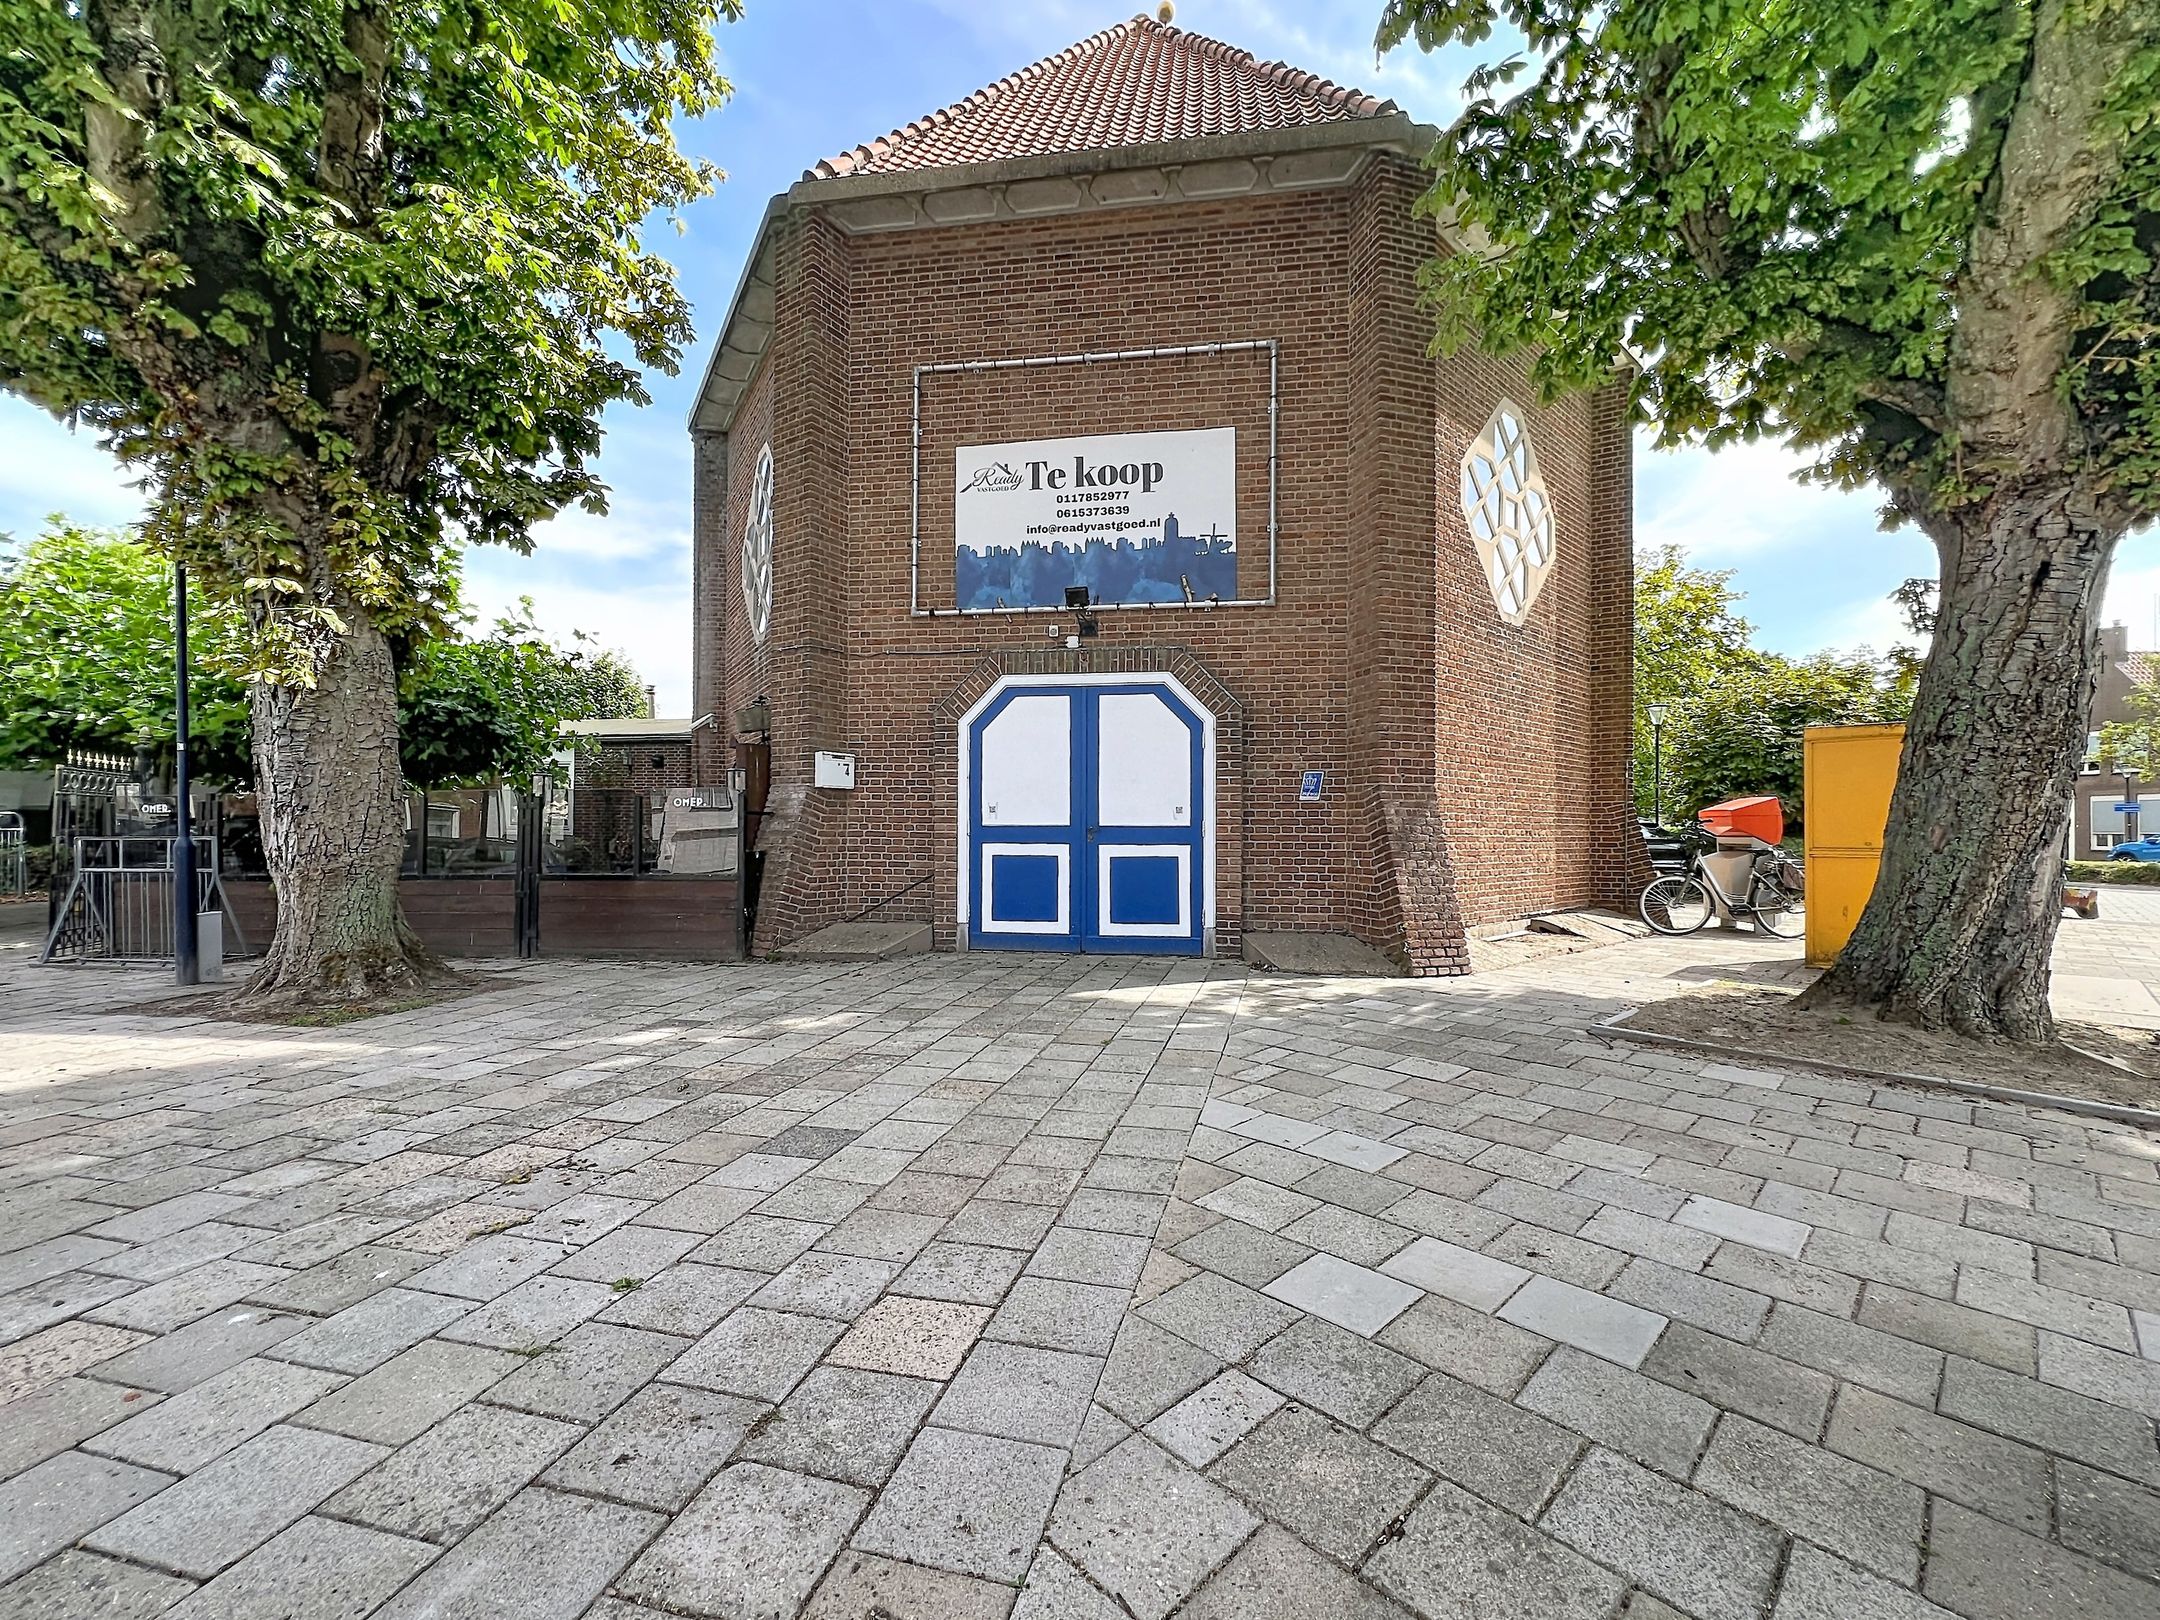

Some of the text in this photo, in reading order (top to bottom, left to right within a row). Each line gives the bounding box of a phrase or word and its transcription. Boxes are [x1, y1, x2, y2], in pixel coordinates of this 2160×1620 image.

[972, 467, 1024, 490] Ready
[1025, 456, 1164, 493] Te koop
[1056, 491, 1129, 503] 0117852977
[1056, 506, 1130, 518] 0615373639
[1026, 518, 1161, 535] info@readyvastgoed.nl
